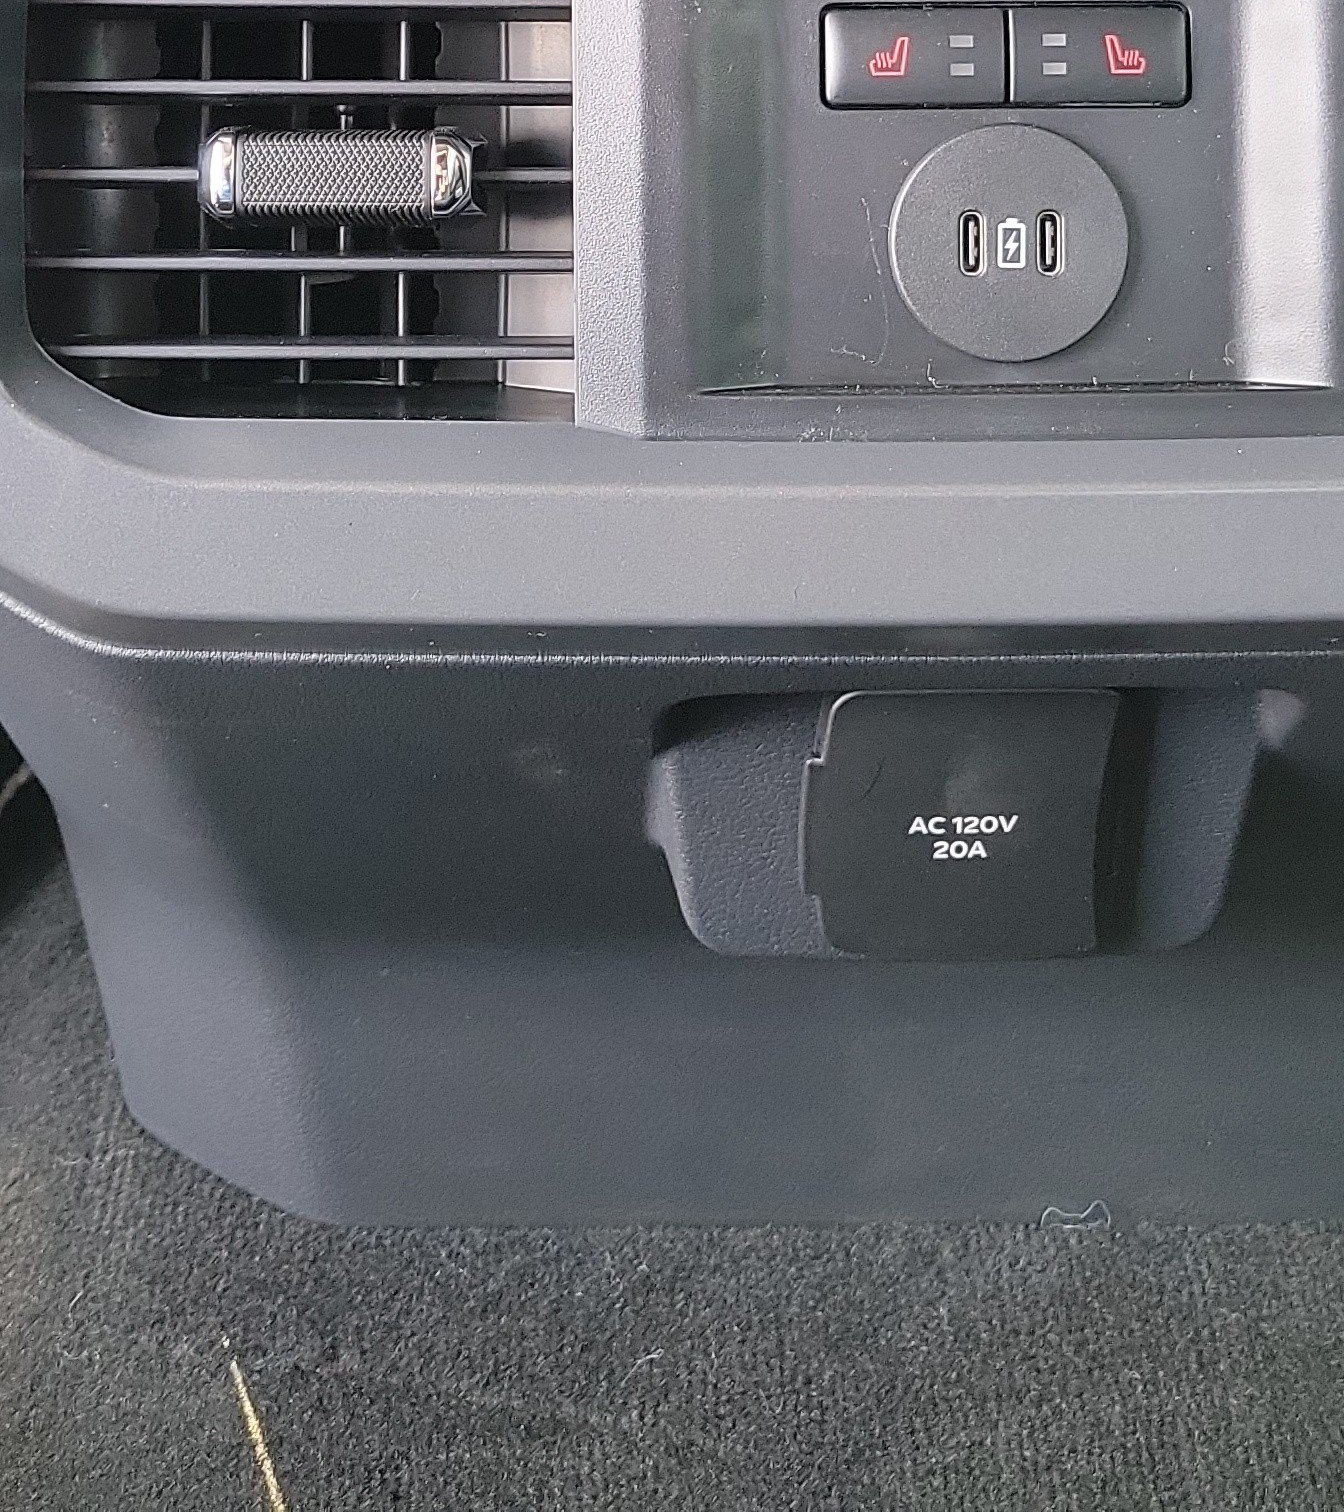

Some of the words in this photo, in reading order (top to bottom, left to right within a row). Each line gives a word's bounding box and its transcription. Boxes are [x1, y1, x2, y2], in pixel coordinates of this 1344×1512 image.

[908, 816, 946, 834] AC
[951, 815, 1019, 834] 120V
[932, 840, 988, 859] 20A
